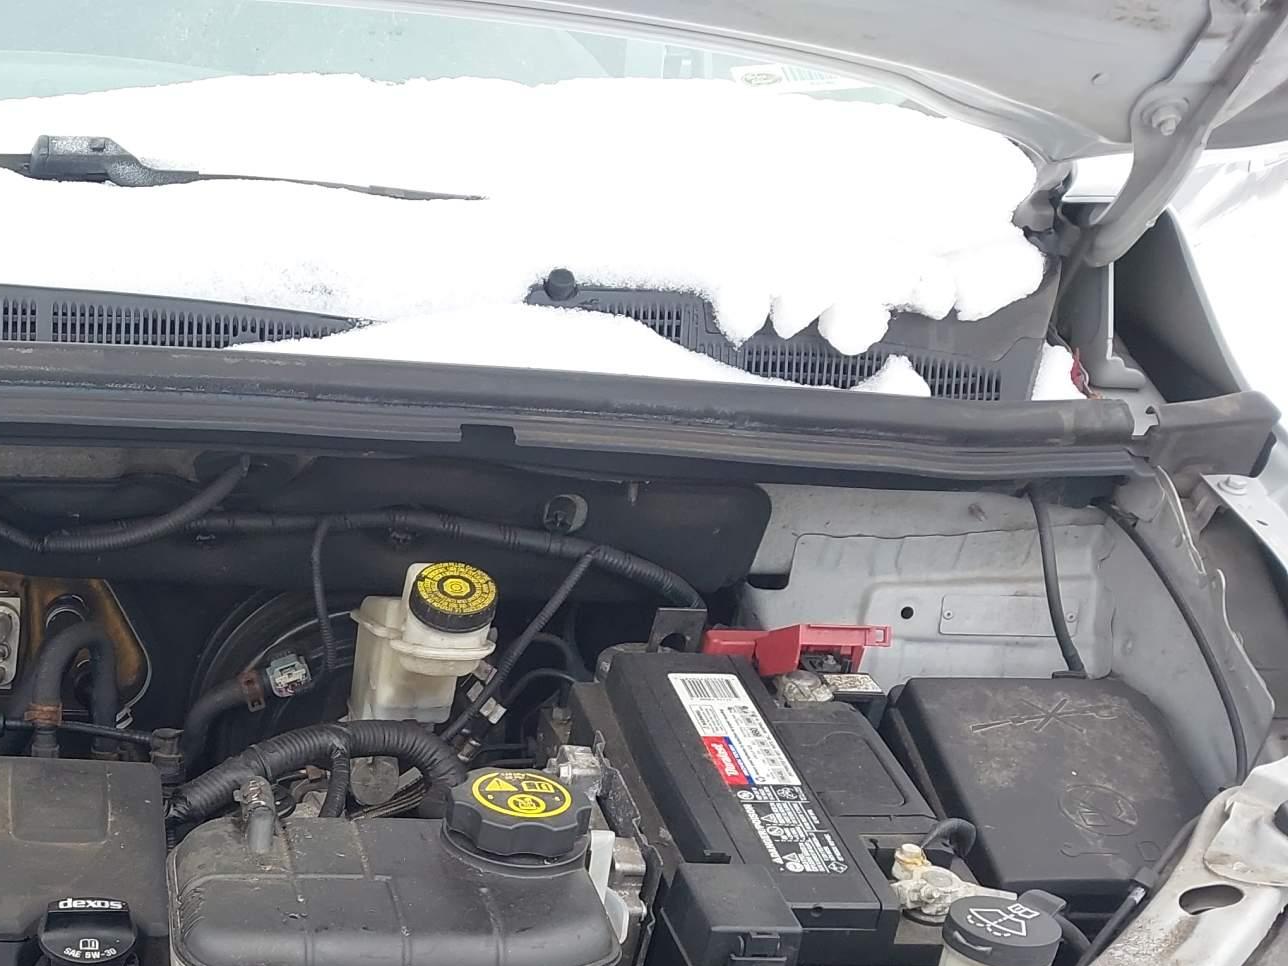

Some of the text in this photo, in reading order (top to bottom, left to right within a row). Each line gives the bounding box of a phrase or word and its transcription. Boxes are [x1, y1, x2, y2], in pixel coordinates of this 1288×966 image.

[58, 898, 123, 910] dexos
[63, 947, 117, 960] SAE 5W-30
